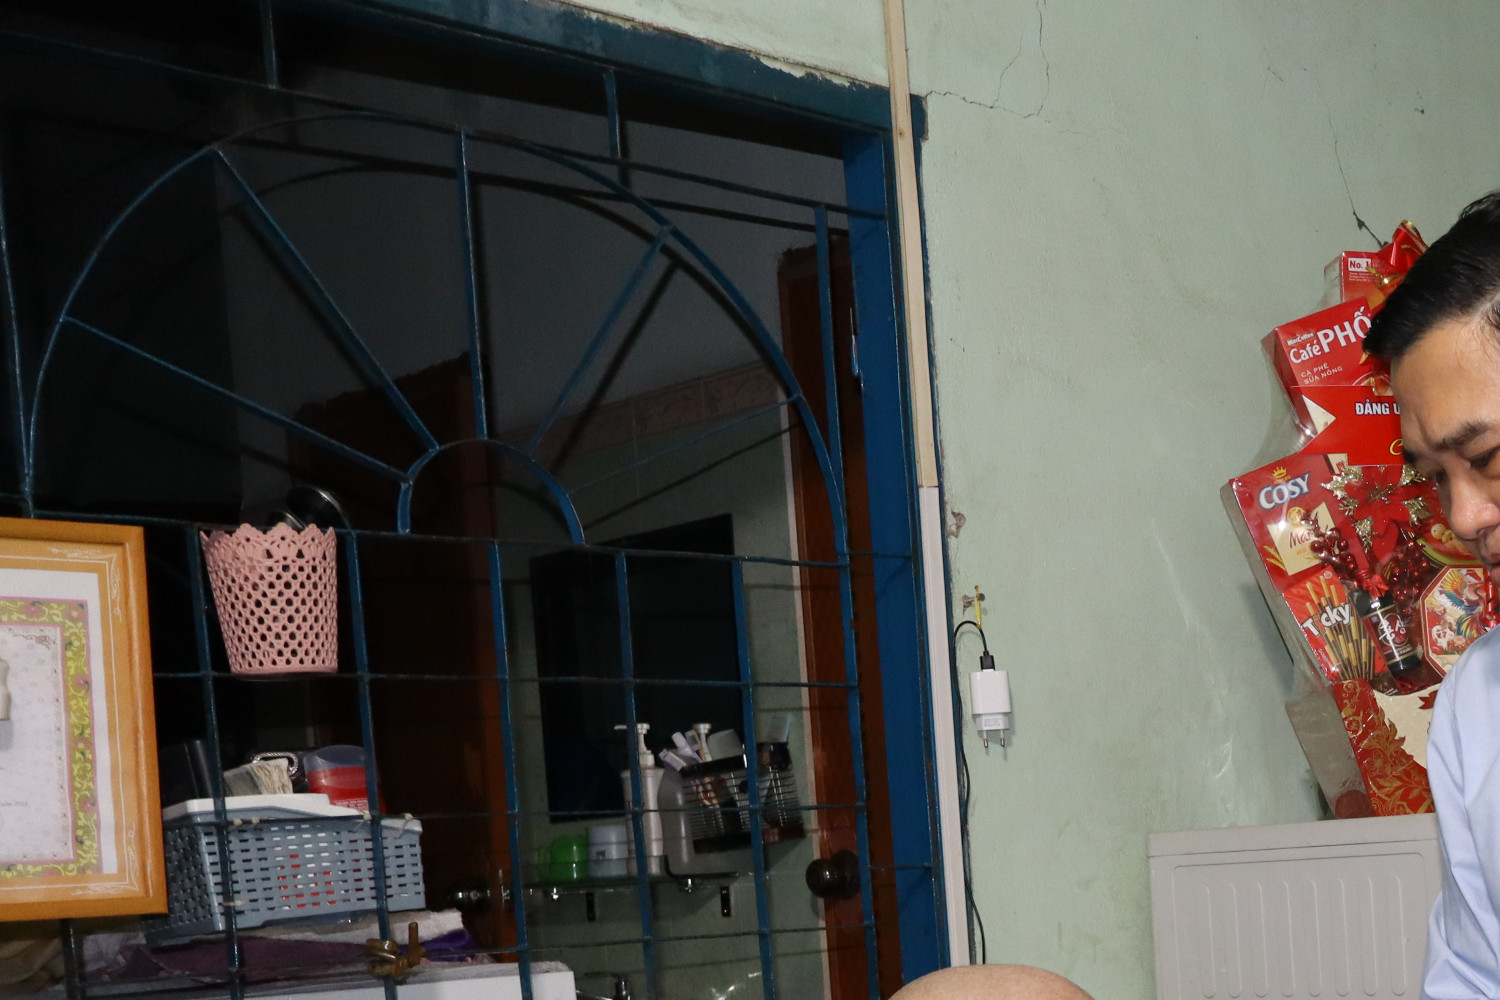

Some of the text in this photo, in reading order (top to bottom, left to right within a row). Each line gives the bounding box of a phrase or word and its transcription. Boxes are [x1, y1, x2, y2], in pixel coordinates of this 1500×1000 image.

[1349, 260, 1363, 269] No.
[1289, 306, 1372, 364] Café PHỐ
[1355, 398, 1390, 415] ĐẢNG
[1258, 471, 1312, 511] COSY
